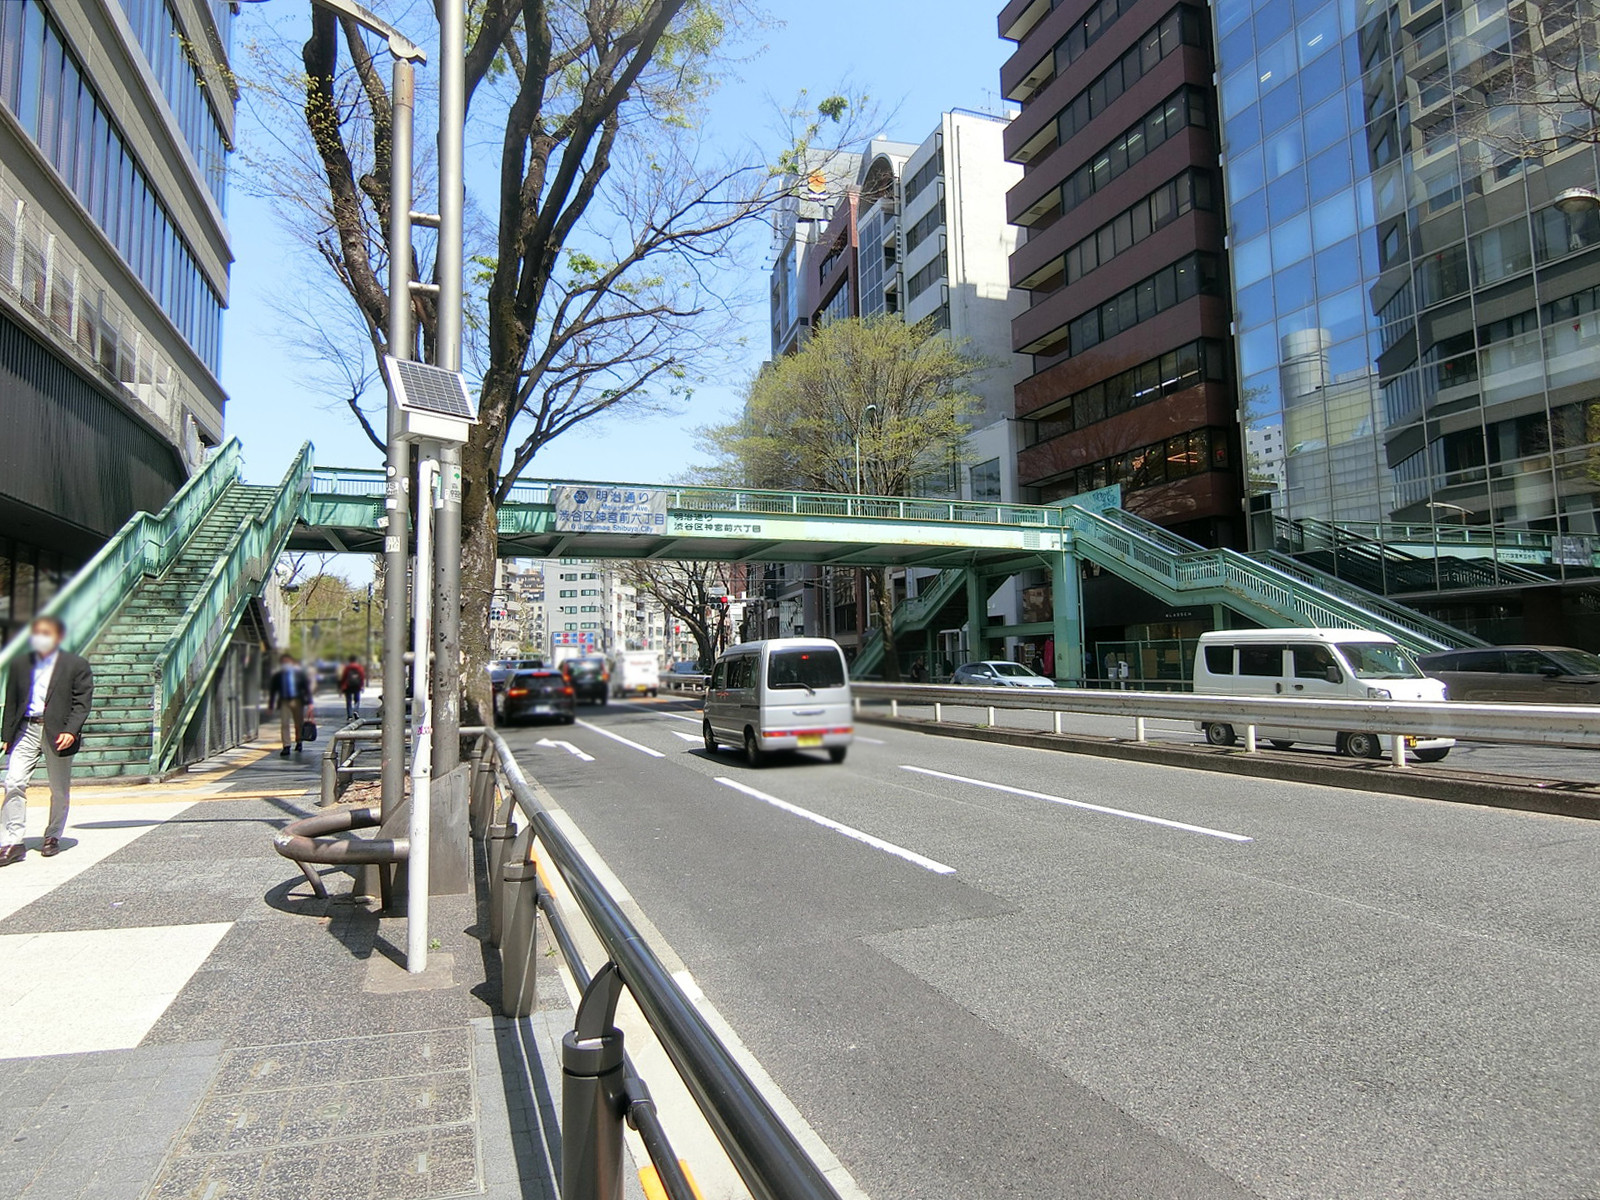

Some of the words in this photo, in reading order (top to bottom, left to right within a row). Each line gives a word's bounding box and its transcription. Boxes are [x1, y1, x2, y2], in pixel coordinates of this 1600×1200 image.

[596, 490, 649, 504] 明治通り
[559, 510, 664, 526] 渋谷区神宮前六丁目
[673, 512, 713, 522] 明治通り
[673, 522, 762, 533] 渋谷区神宮前六丁目
